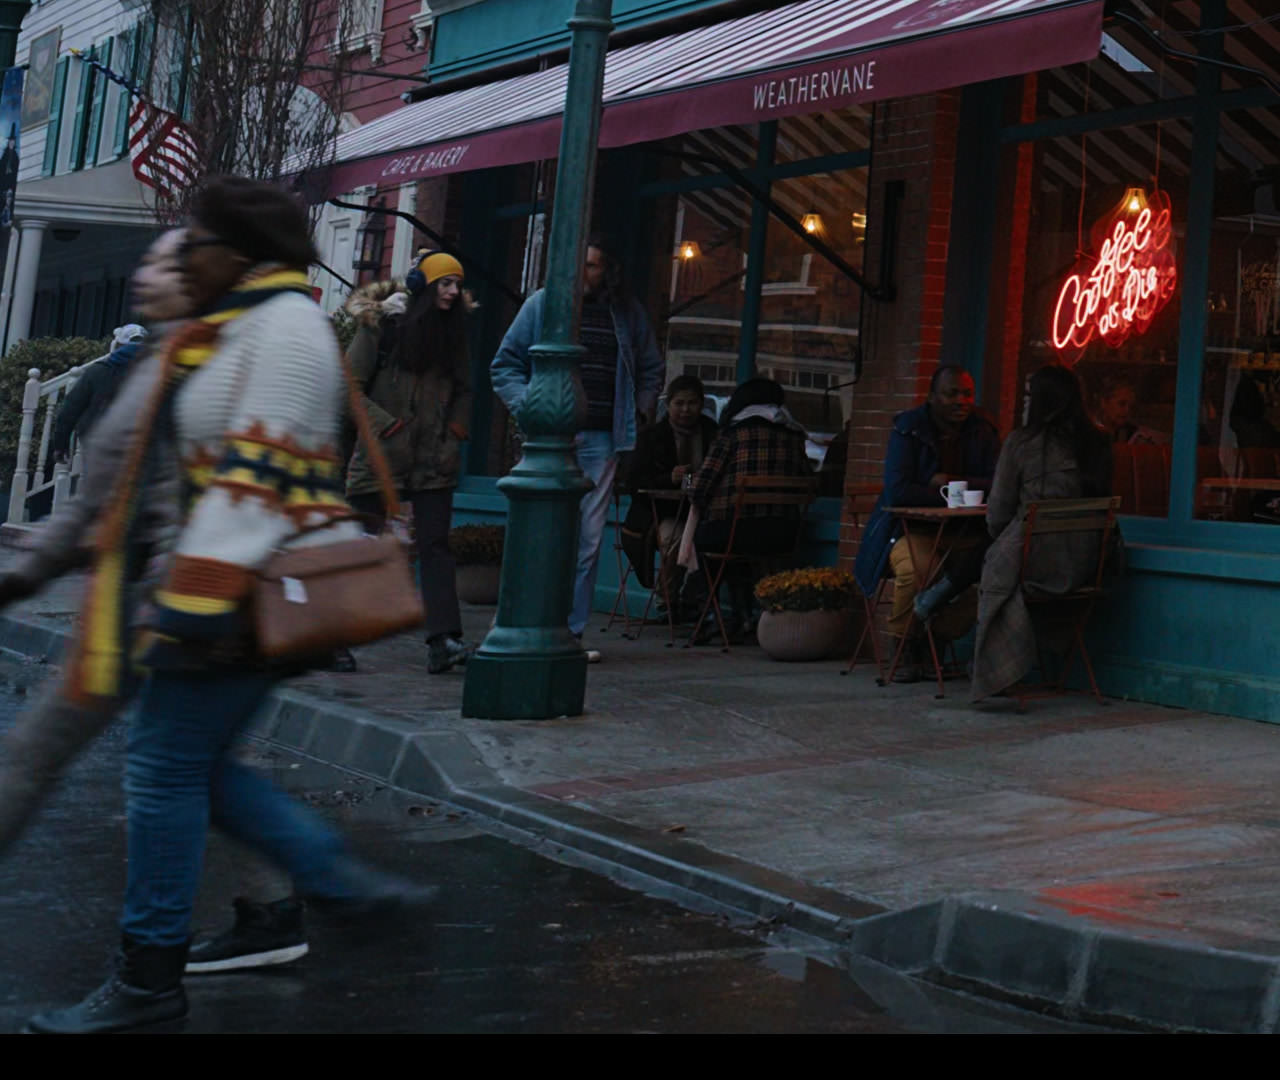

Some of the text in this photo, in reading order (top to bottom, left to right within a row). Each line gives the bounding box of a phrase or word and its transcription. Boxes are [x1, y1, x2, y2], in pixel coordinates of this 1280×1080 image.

[753, 61, 876, 110] WEATHERVANE
[382, 156, 416, 176] CAFE
[421, 144, 470, 171] BAKERY
[1054, 208, 1152, 348] Coffee
